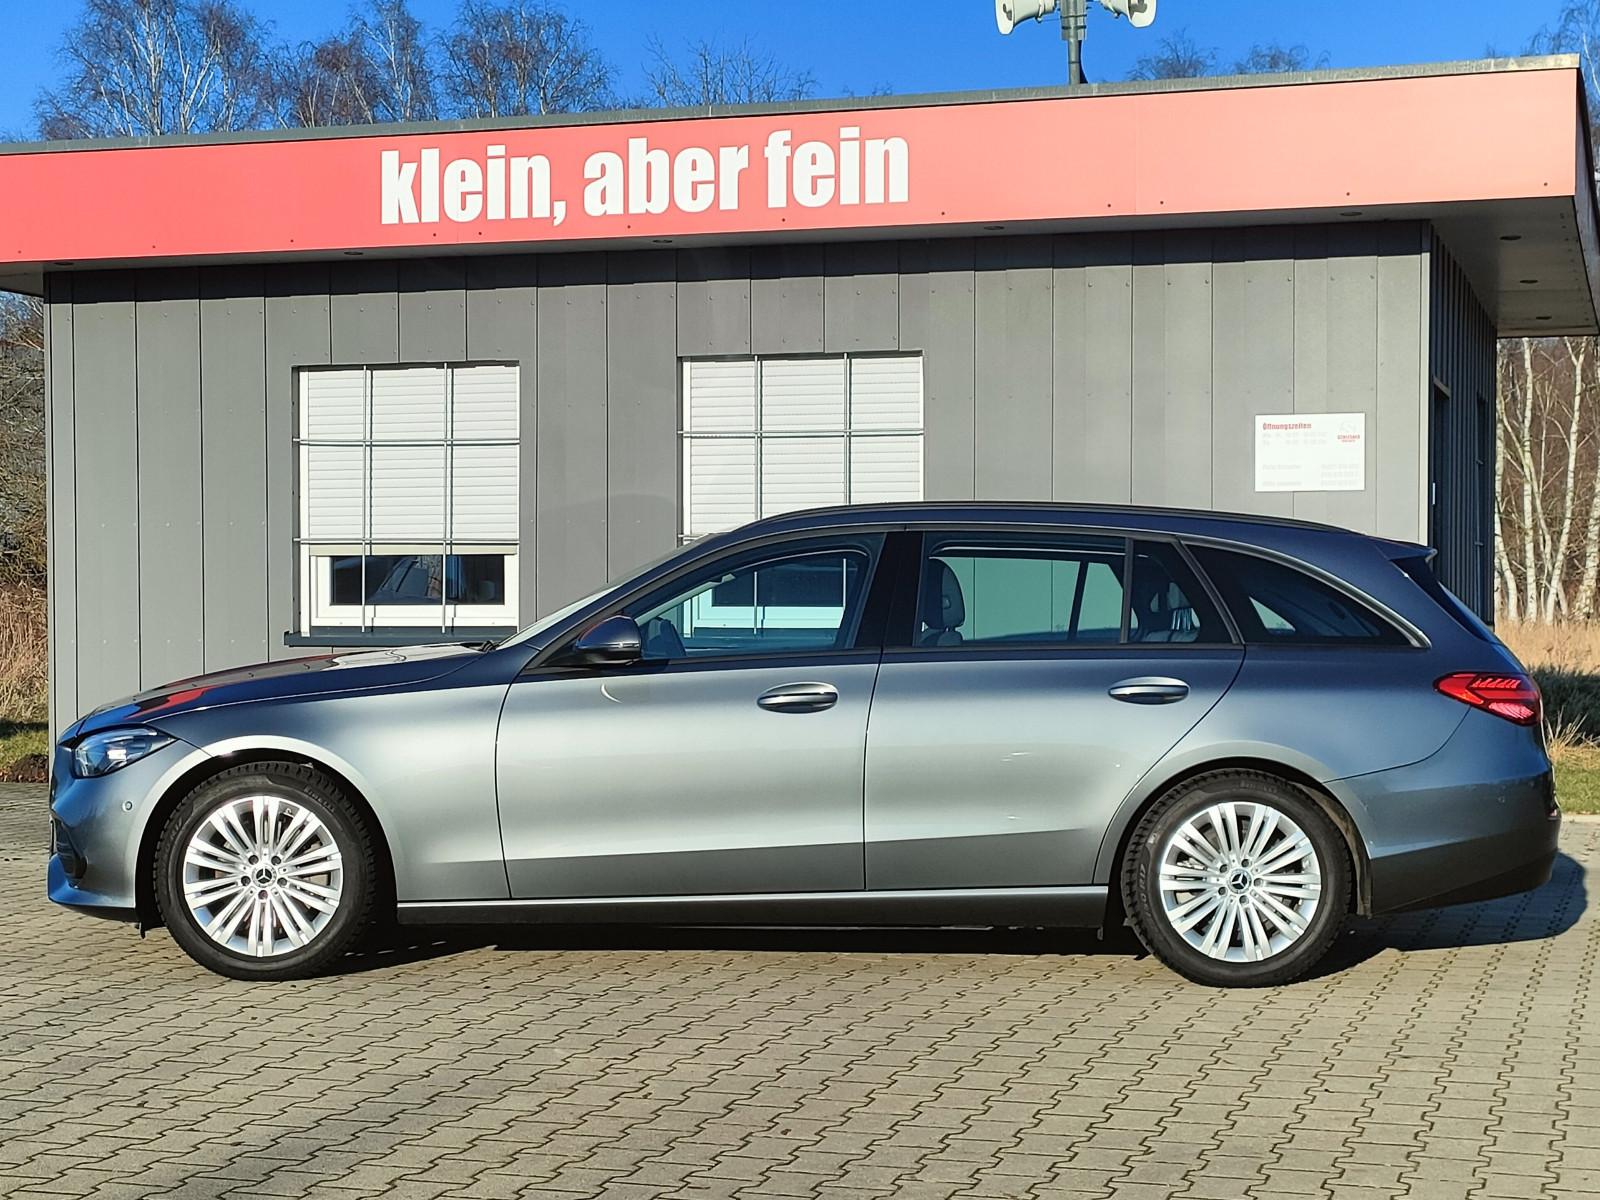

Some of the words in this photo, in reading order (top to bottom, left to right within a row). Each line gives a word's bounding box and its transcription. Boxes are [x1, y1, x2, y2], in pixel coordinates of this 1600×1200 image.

[381, 144, 567, 227] klein,
[583, 137, 750, 217] aber
[763, 126, 909, 209] fein
[1262, 422, 1312, 431] Öffnungszeiten
